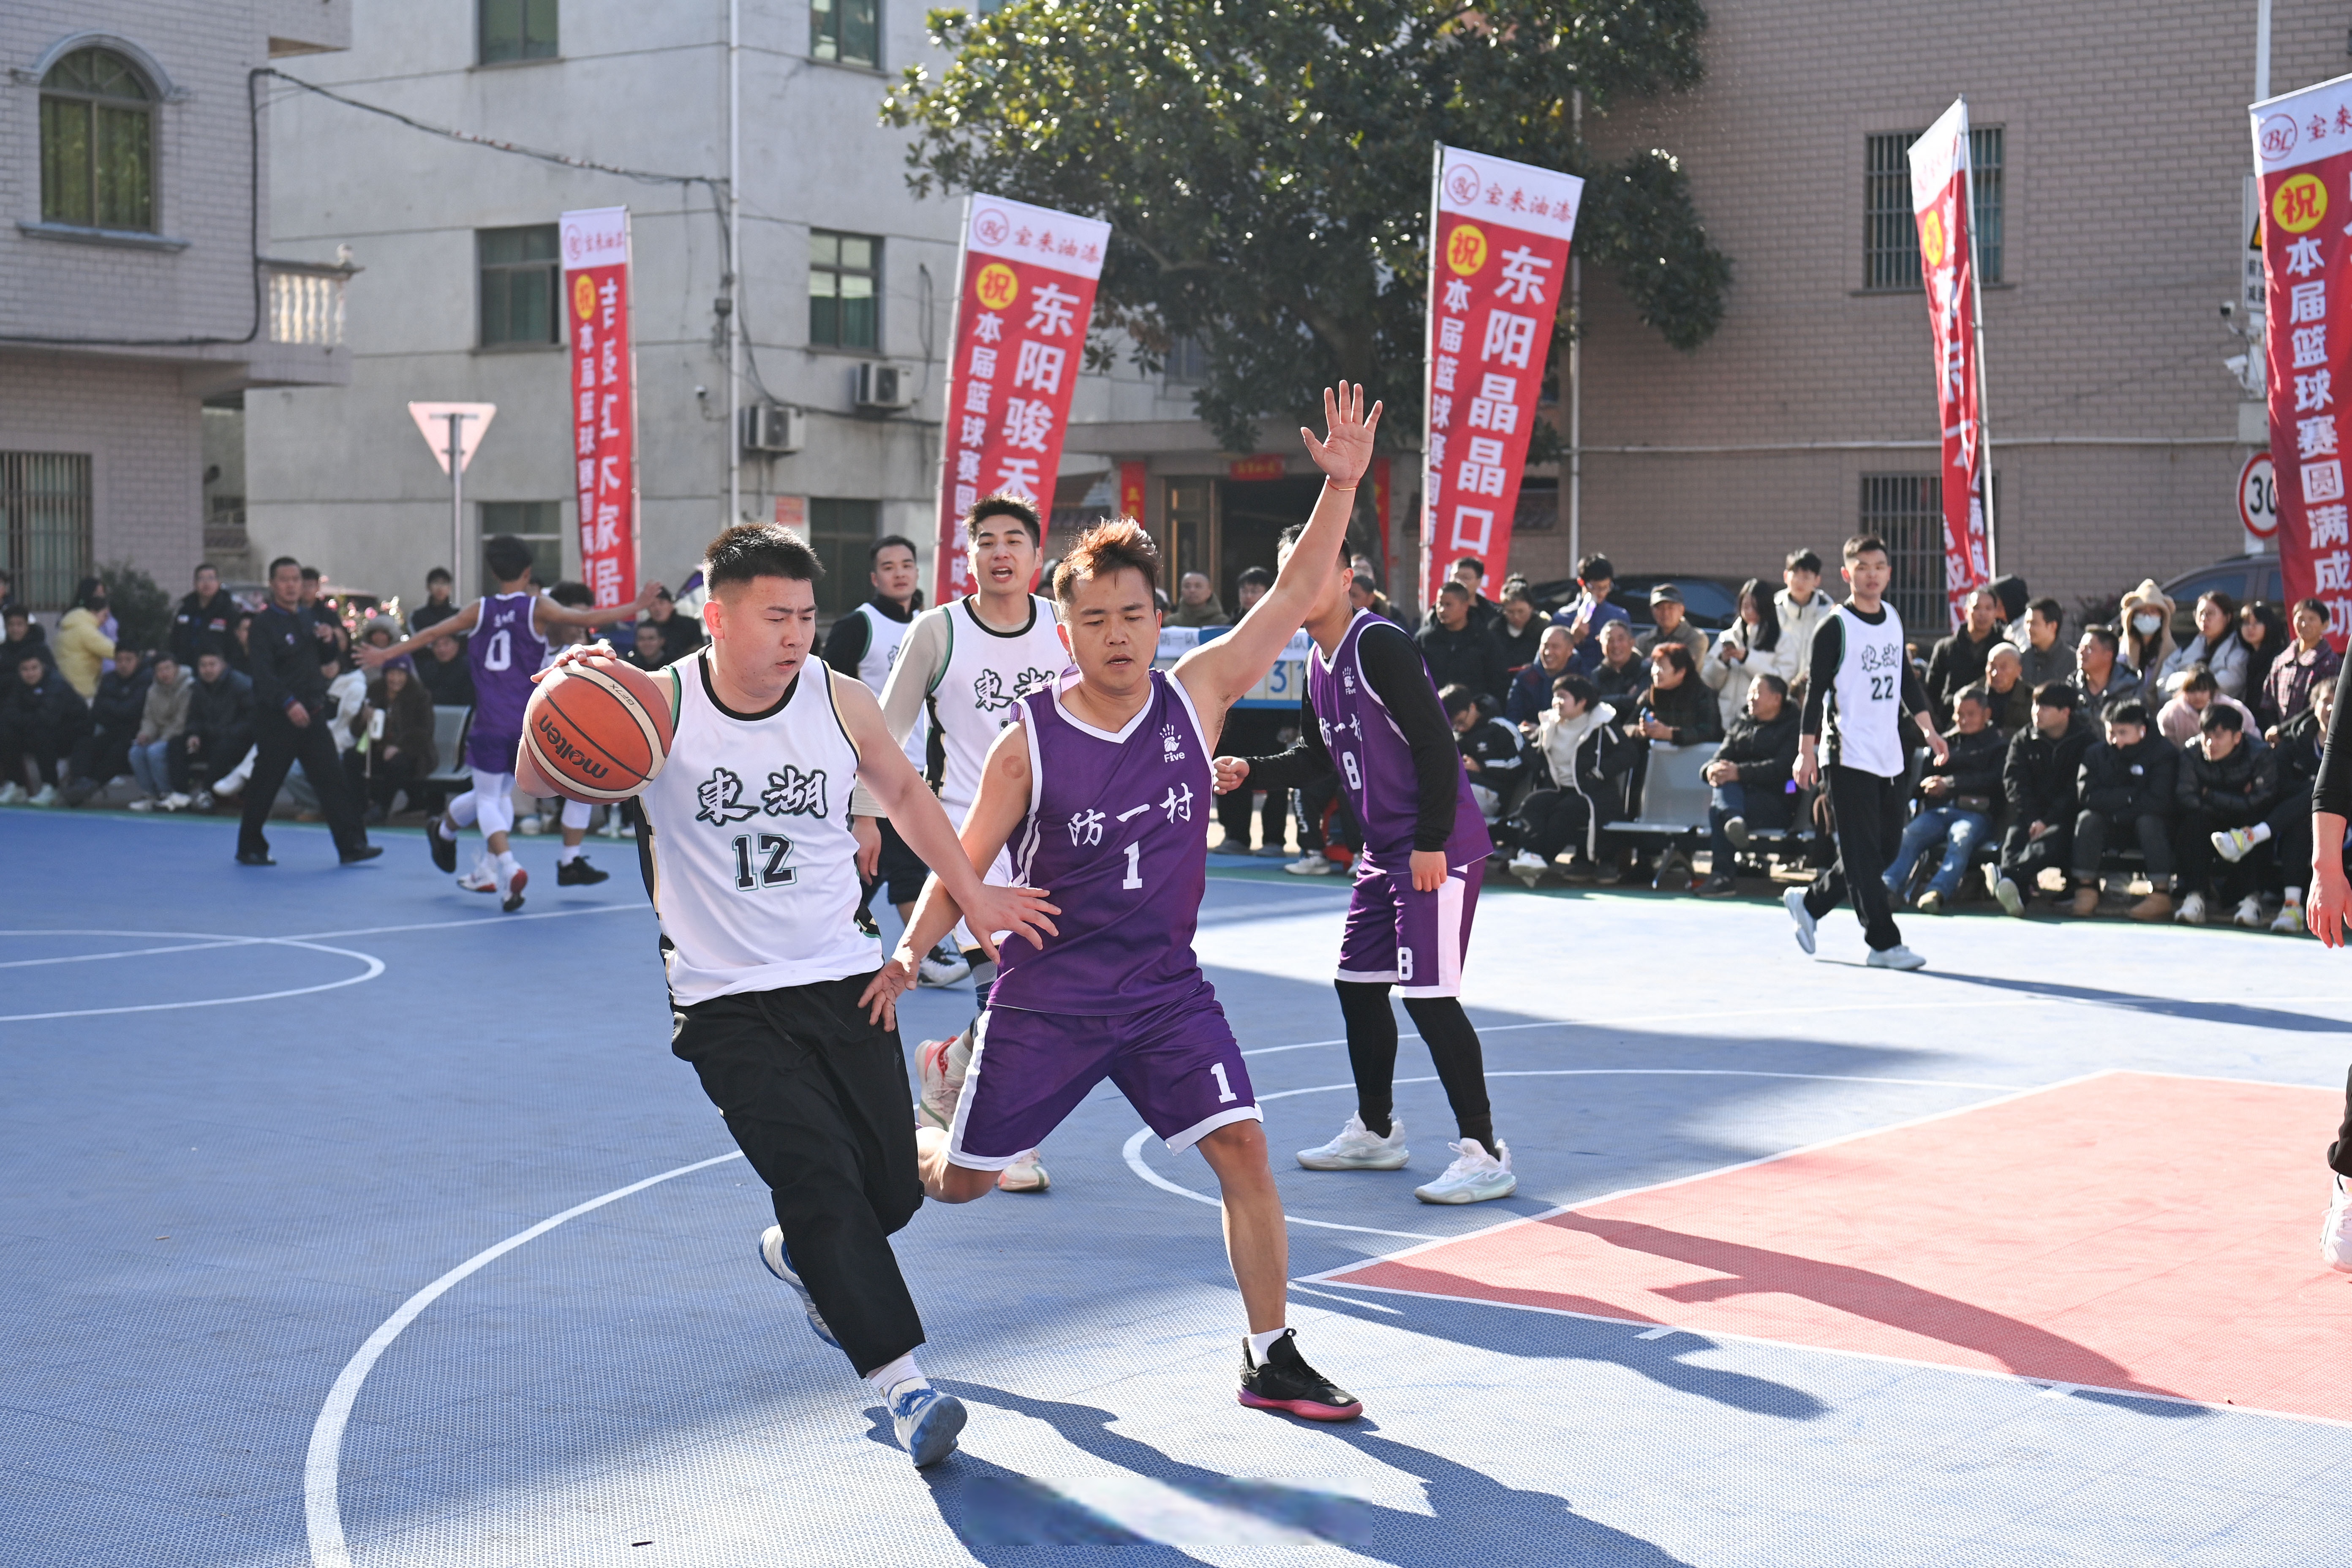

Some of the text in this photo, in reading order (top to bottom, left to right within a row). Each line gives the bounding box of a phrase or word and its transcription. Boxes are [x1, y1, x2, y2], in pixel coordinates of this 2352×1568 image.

[2281, 182, 2320, 226] 祝
[1451, 231, 1481, 269] 祝
[983, 270, 1012, 303] 祝
[991, 282, 1081, 503] 东阳骏天
[1443, 245, 1553, 597] 东阳晶晶口
[2285, 235, 2352, 637] 本届篮球赛圆满成功
[950, 311, 1004, 599] 本届篮球赛圆满成
[2250, 475, 2276, 515] 30
[484, 629, 511, 671] 0
[609, 683, 634, 705] GF7X
[1270, 661, 1287, 693] 3
[1345, 687, 1356, 695] Five
[1871, 675, 1893, 701] 22
[539, 713, 609, 779] molten
[1164, 751, 1185, 763] Five
[1342, 751, 1362, 790] 8
[695, 764, 828, 827] 東湖
[1067, 782, 1194, 847] 防一村
[732, 833, 798, 892] 12
[1123, 840, 1143, 890] 1
[1397, 947, 1413, 980] 8
[1210, 1062, 1238, 1104] 1
